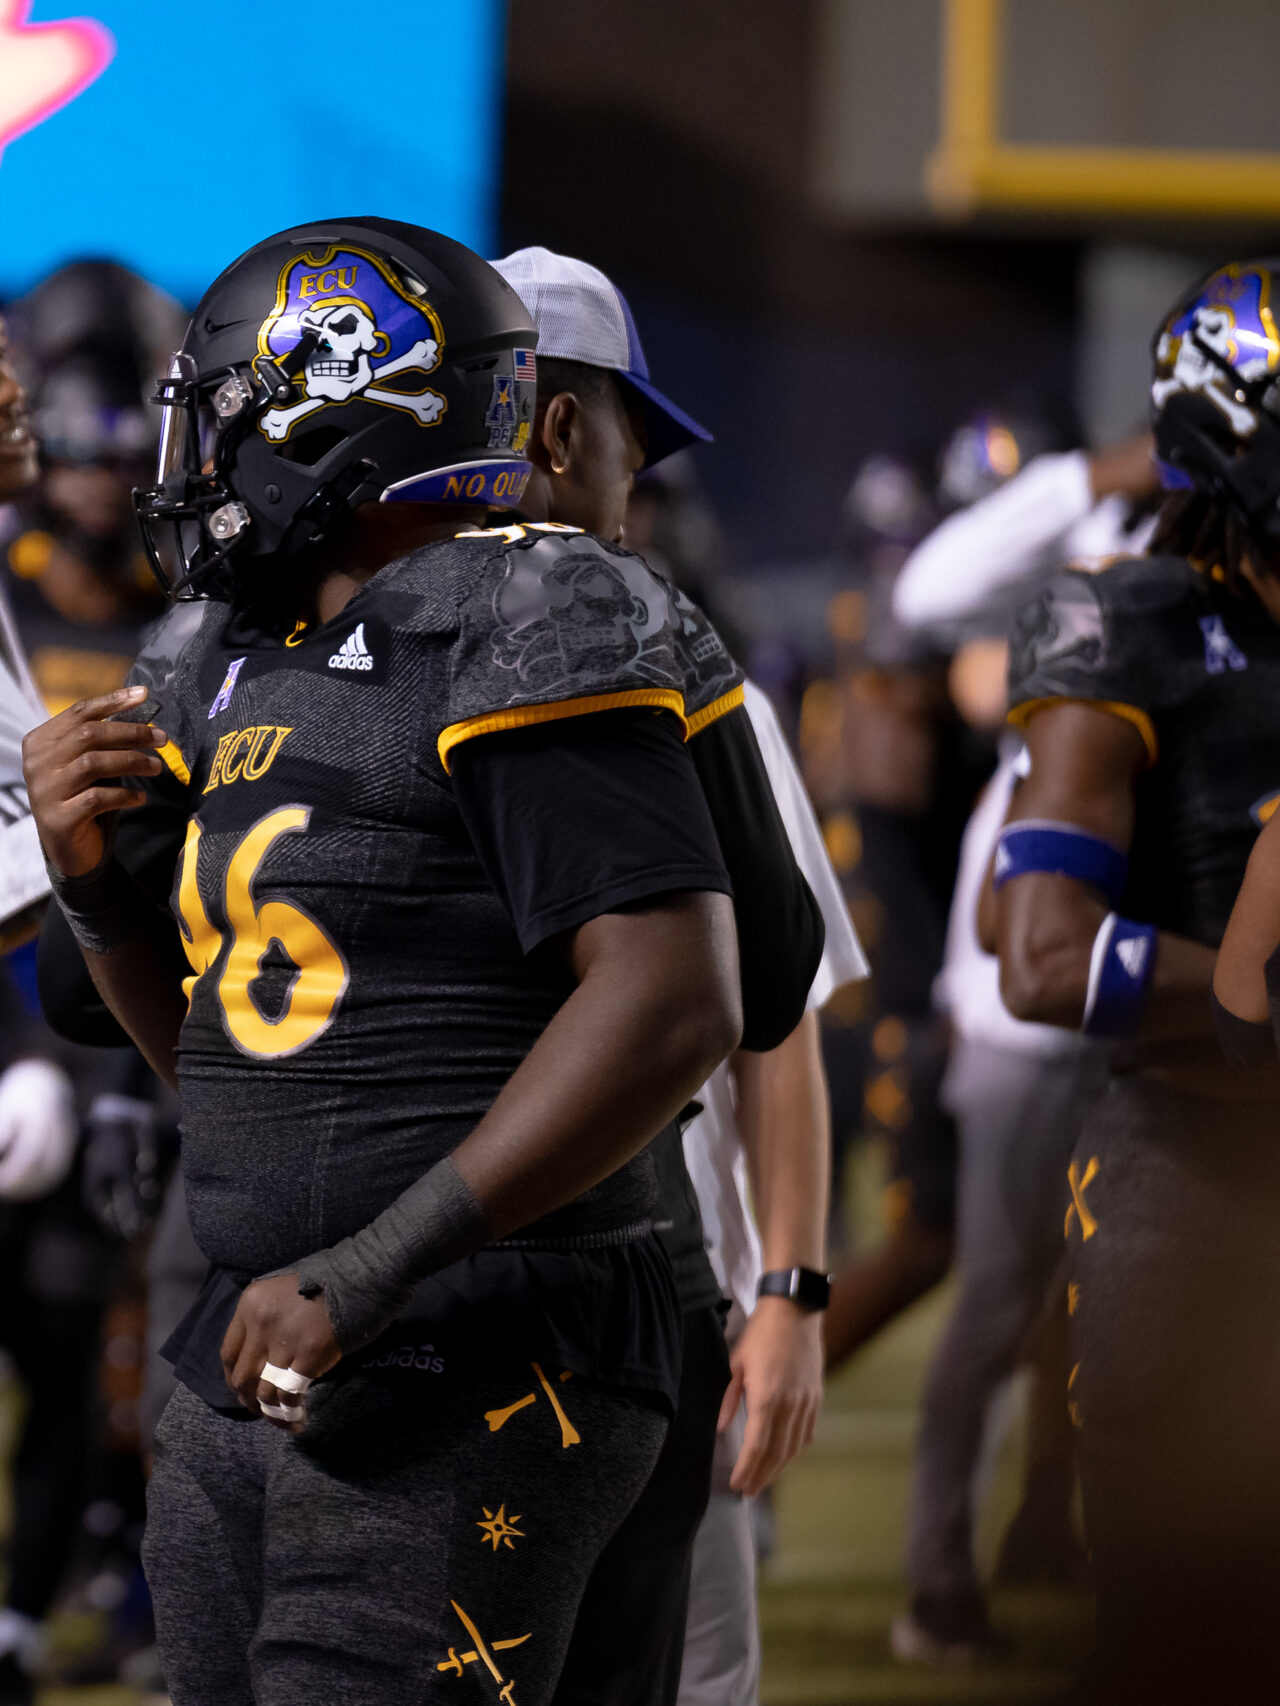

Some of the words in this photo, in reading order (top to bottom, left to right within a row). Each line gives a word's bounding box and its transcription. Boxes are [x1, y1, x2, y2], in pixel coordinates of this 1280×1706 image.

[297, 266, 359, 299] ECU
[441, 473, 486, 499] NO
[328, 653, 374, 671] adidas
[202, 725, 294, 795] ECU
